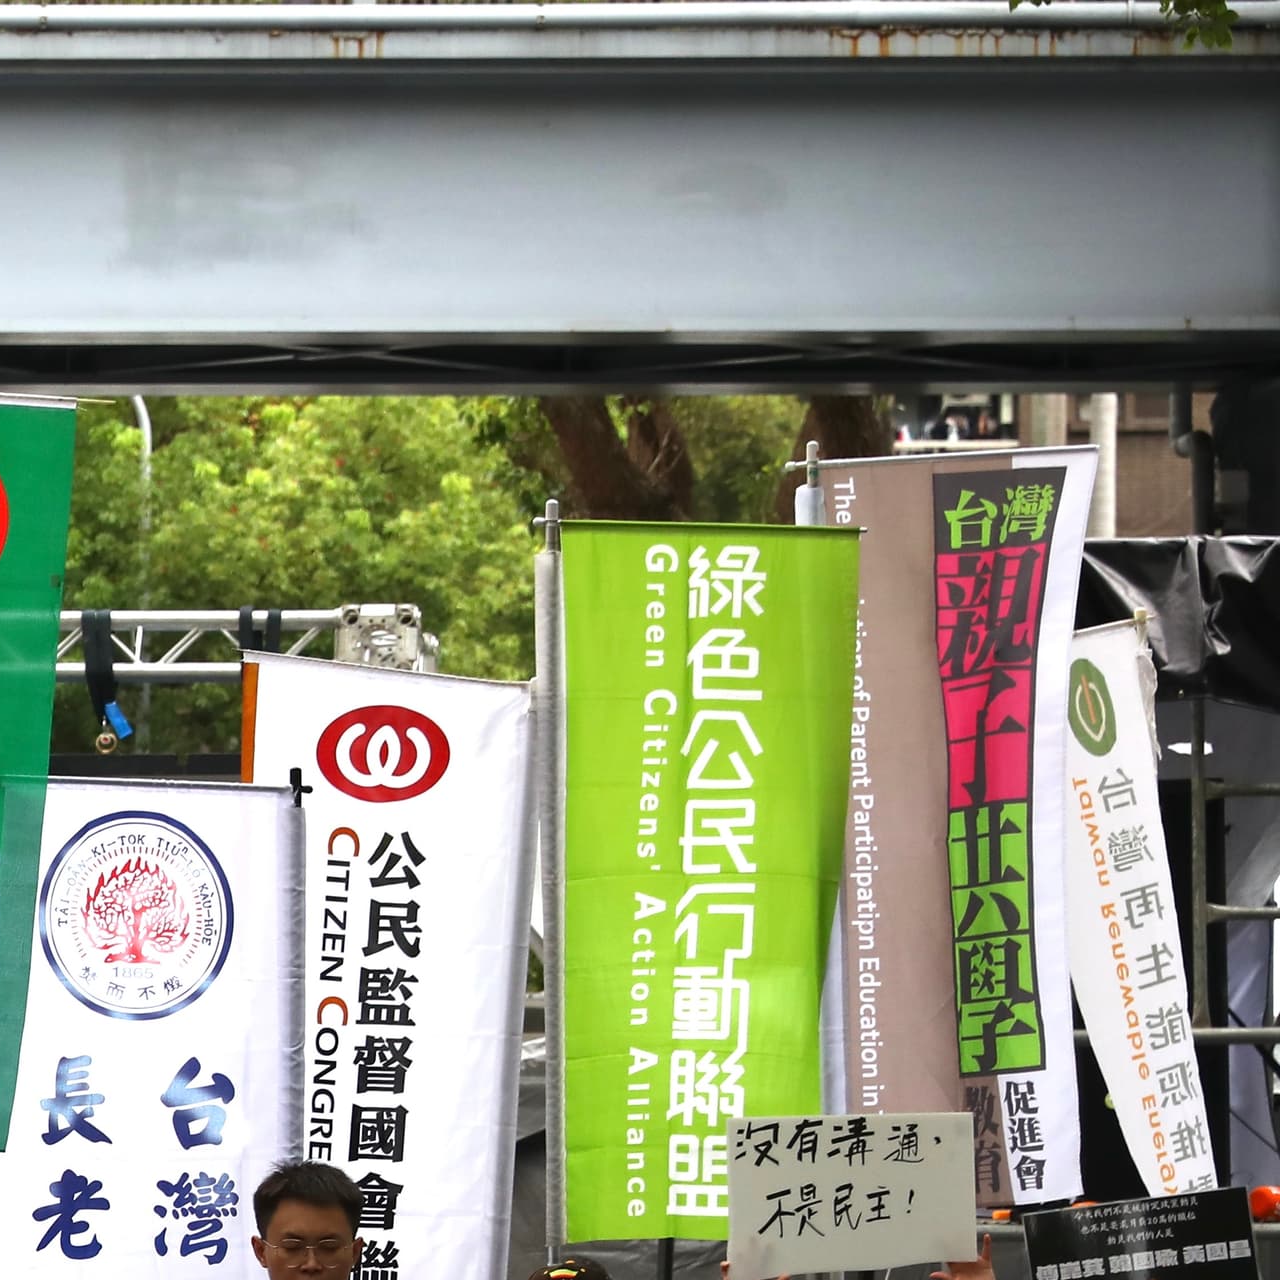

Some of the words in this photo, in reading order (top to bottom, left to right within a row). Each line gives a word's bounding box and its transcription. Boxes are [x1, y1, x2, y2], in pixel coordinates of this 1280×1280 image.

[833, 477, 856, 524] The
[944, 484, 1056, 549] 台灣
[644, 543, 679, 668] Green
[637, 688, 678, 871] Citizens'
[851, 706, 872, 787] Parent
[321, 826, 360, 982] CITIZEN
[666, 544, 767, 1217] 綠色公民行動聯盟
[113, 966, 154, 980] 1865
[630, 891, 666, 1025] Action
[858, 957, 884, 1078] Education
[308, 996, 348, 1163] CONGRE
[626, 1047, 659, 1217] Alliance
[863, 1086, 885, 1107] in
[1004, 1081, 1047, 1192] 促進會
